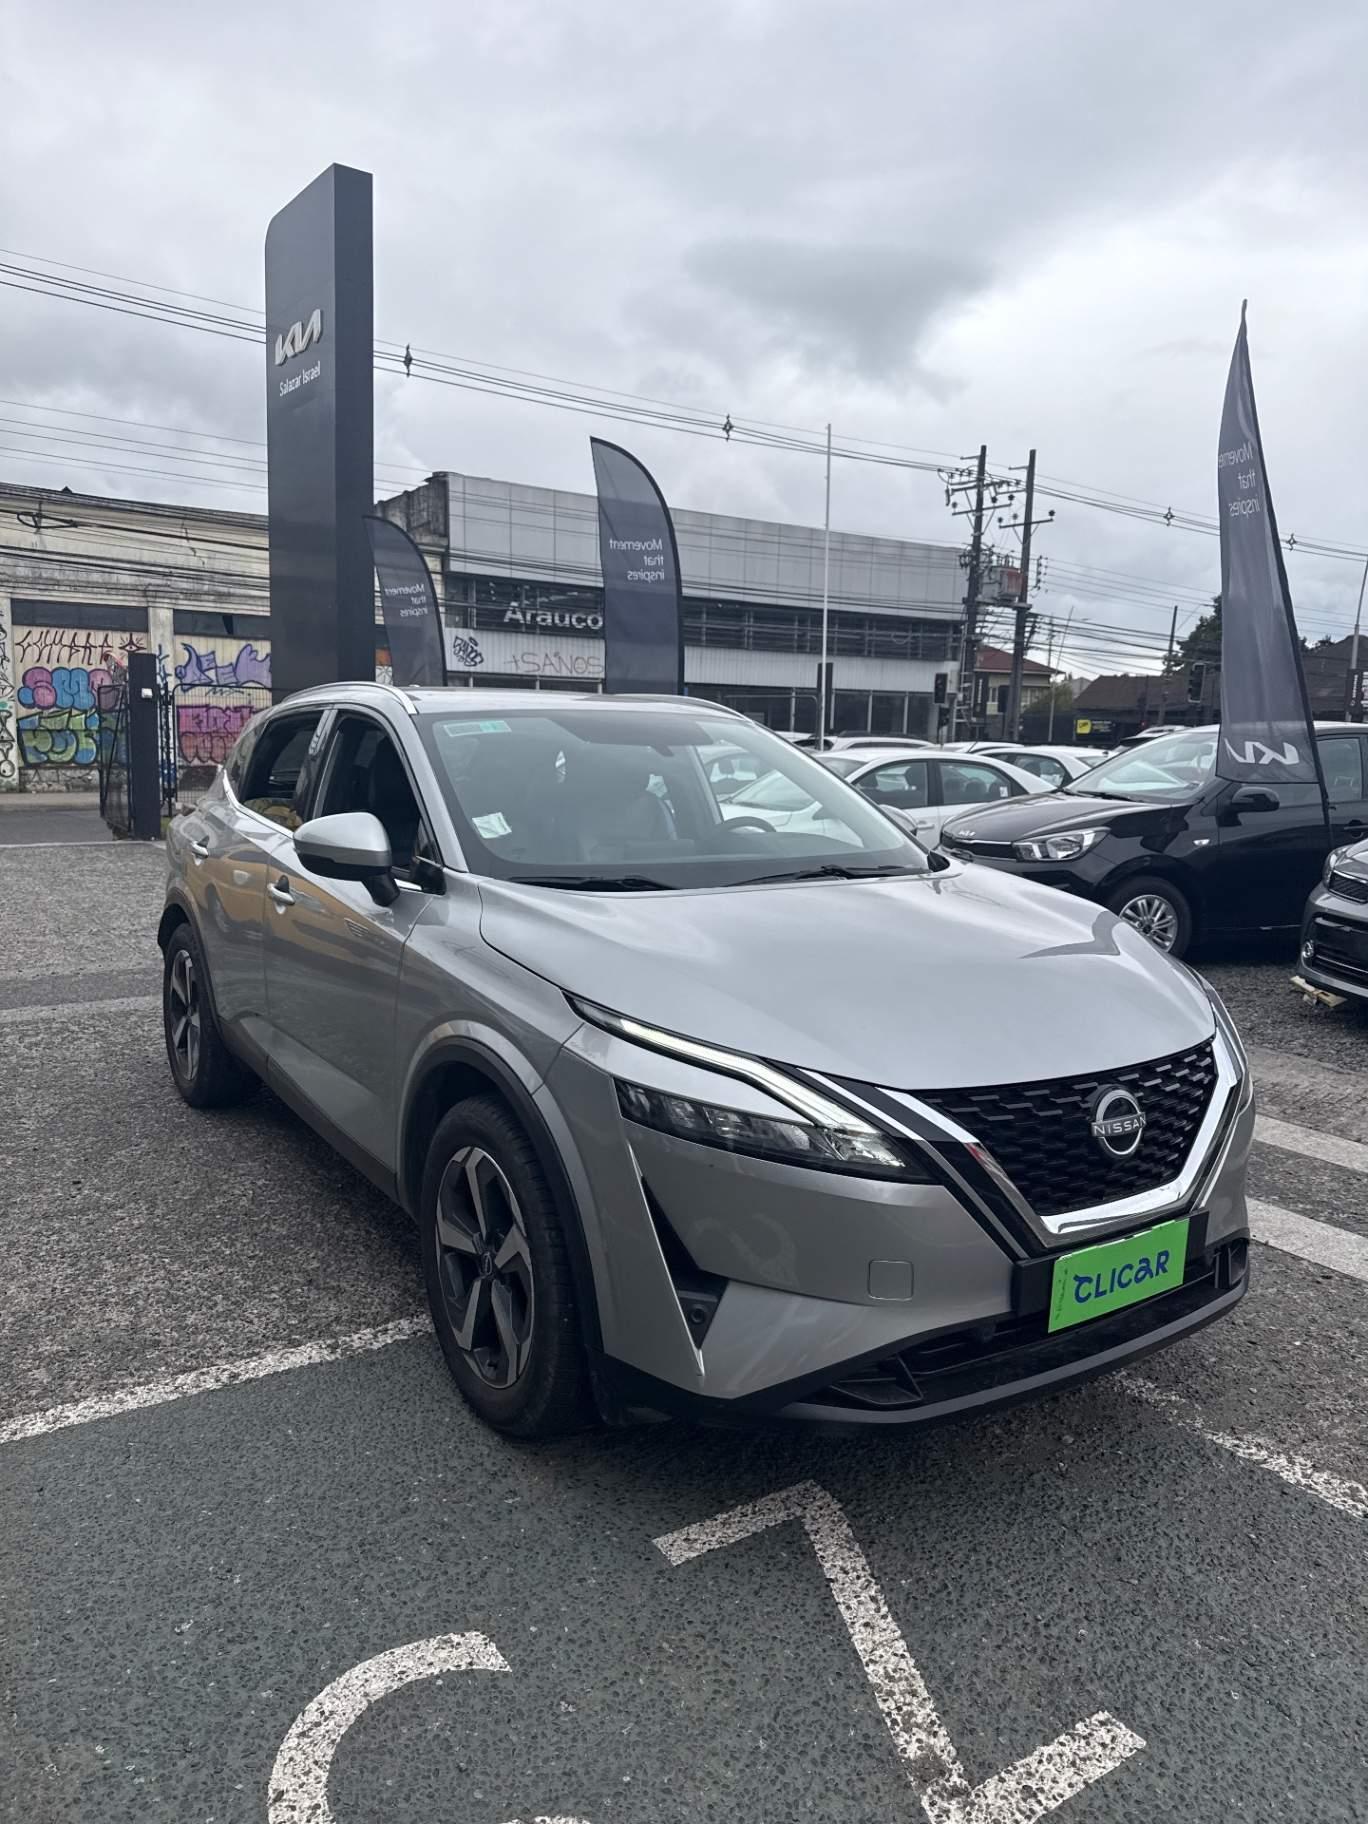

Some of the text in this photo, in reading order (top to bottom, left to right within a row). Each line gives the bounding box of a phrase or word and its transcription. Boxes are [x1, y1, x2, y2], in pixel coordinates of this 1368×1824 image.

[279, 361, 321, 397] Salazar Israel
[503, 601, 604, 630] Arauco
[1093, 1114, 1146, 1137] NISSAN
